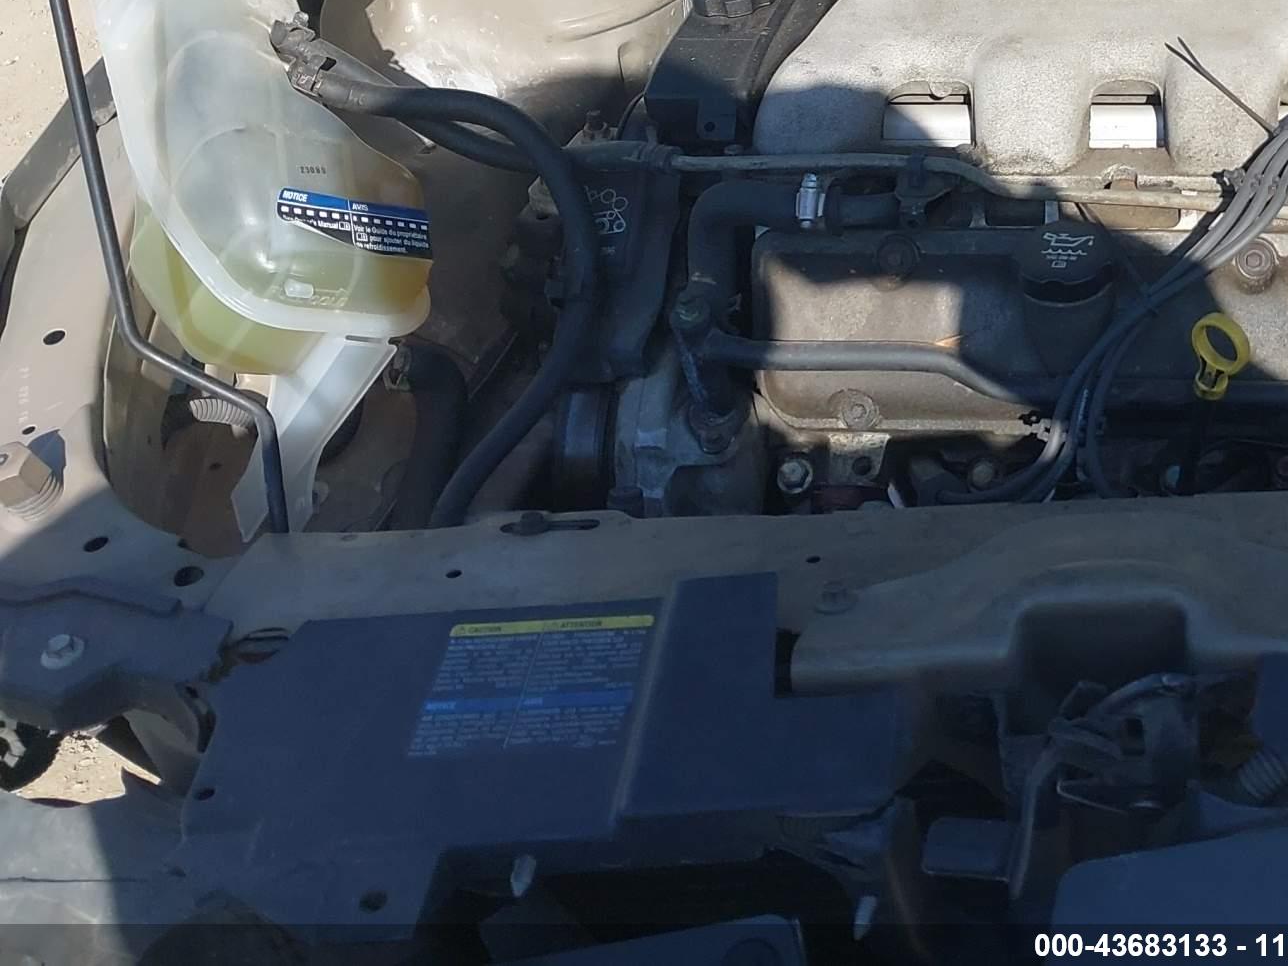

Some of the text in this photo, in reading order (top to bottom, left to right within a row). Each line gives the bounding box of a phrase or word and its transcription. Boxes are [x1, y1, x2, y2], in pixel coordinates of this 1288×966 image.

[282, 191, 368, 211] NOTICE AVIS
[468, 620, 602, 634] CAUTION ATTENTION
